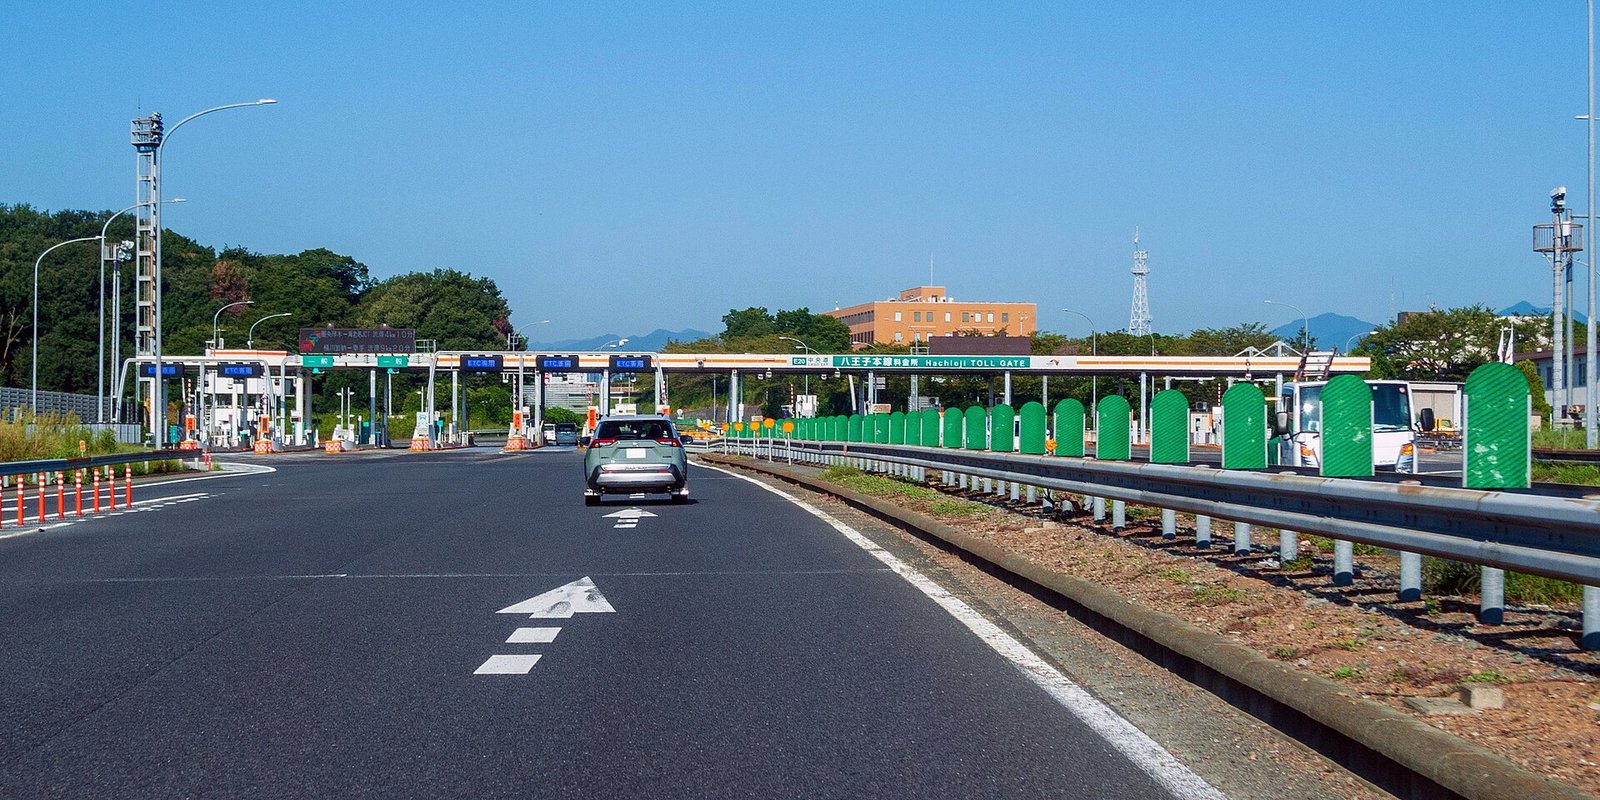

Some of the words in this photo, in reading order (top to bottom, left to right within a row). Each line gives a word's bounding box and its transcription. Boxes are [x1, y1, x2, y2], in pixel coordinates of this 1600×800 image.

[841, 357, 918, 366] 八王子本線料金所
[925, 359, 966, 368] Hachioji
